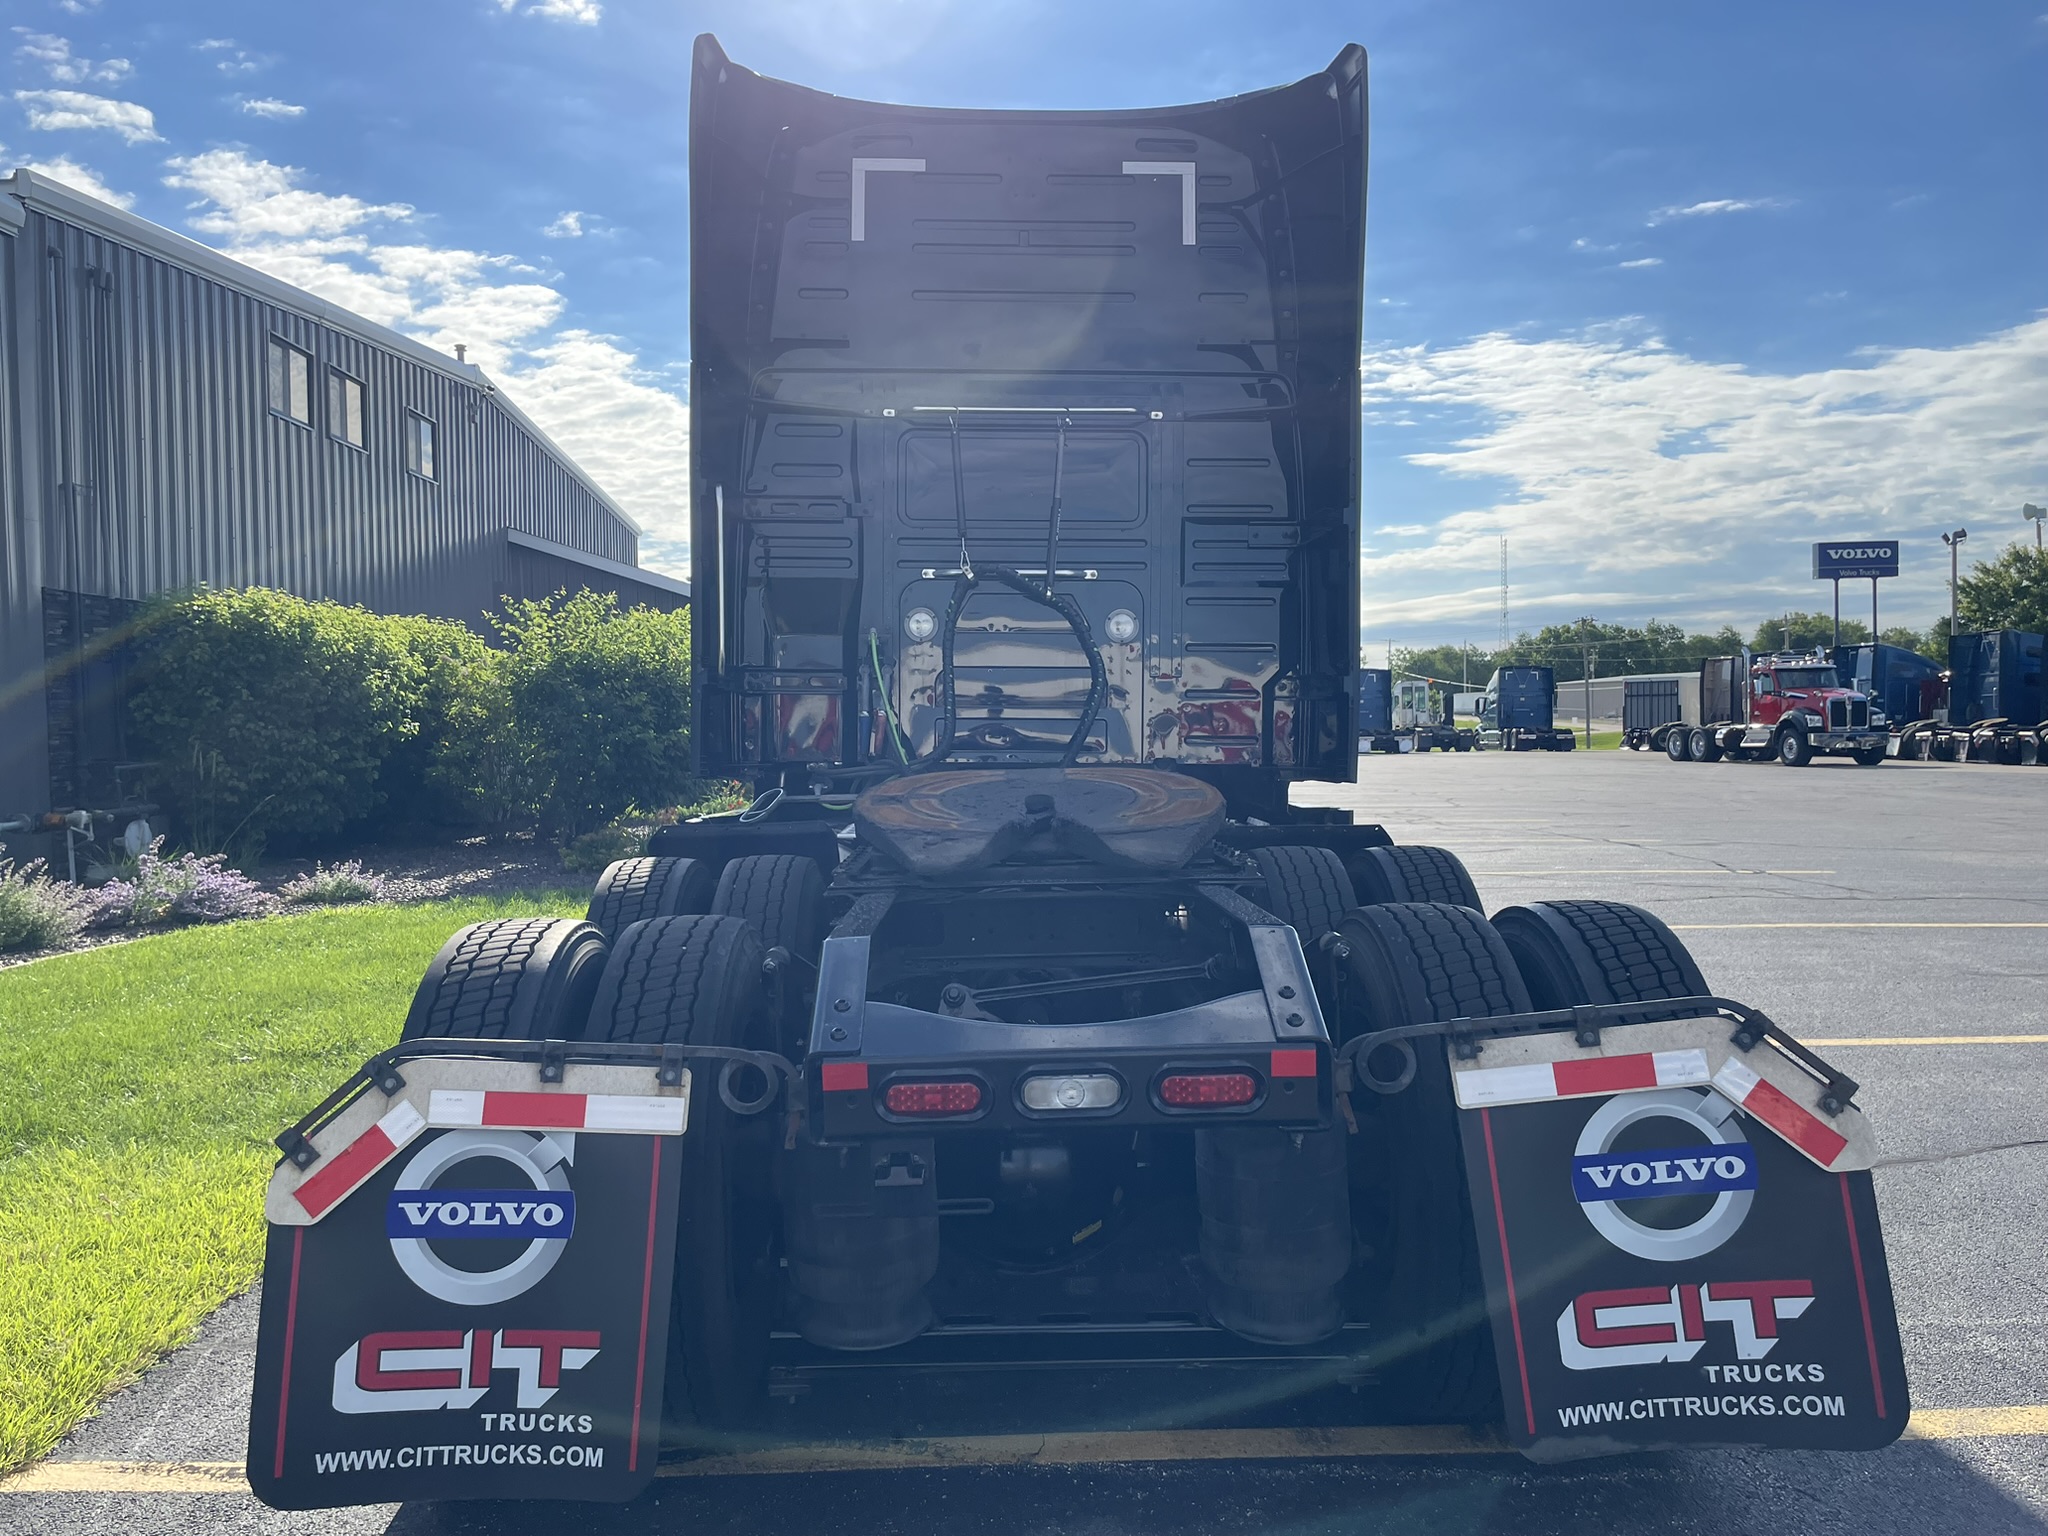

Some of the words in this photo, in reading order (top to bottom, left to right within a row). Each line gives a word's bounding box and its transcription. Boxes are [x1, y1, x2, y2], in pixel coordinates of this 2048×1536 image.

[1827, 548, 1892, 559] VOLVO
[1839, 569, 1858, 577] Volvo
[1859, 568, 1880, 577] Trucks
[1582, 1155, 1746, 1189] VOLVO
[398, 1202, 564, 1226] VOLVO
[1557, 1279, 1815, 1370] CIT
[332, 1328, 601, 1414] CIT
[1706, 1363, 1825, 1383] TRUCKS
[480, 1413, 593, 1433] TRUCKS
[1558, 1395, 1846, 1427] WWW.CITTRUCKS.COM
[315, 1445, 604, 1474] WWW.CITTRUCKS.COM
